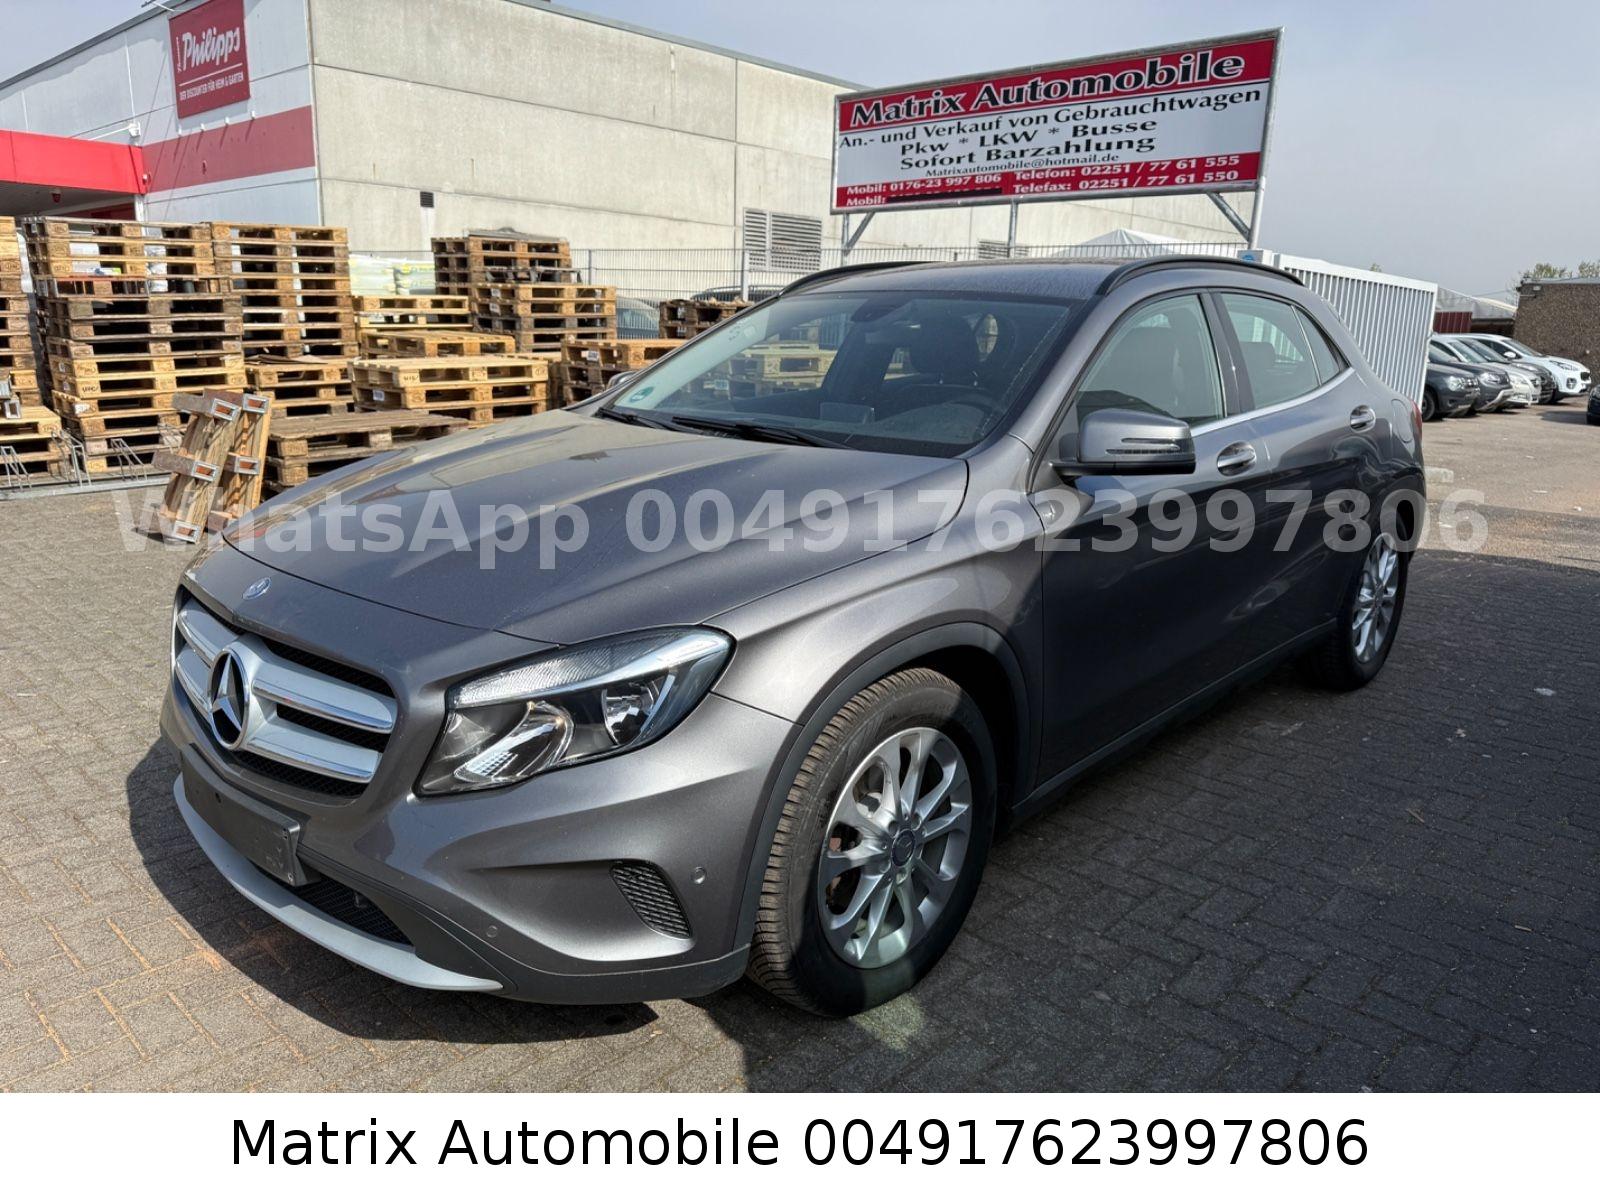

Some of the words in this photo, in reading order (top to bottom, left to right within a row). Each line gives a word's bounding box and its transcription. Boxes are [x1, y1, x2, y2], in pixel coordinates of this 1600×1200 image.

[182, 26, 240, 71] Philipps
[850, 89, 967, 127] Matrix
[969, 50, 1245, 111] Automobile
[839, 136, 875, 149] An.-
[881, 126, 916, 144] und
[924, 115, 1002, 138] Verkauf
[1009, 114, 1048, 128] von
[1054, 89, 1261, 123] Gebrauchtwagen
[901, 142, 949, 156] Pkw
[979, 129, 1038, 147] LKW
[1072, 120, 1158, 138] Busse
[900, 151, 976, 170] Sofort
[986, 137, 1156, 163] Barzahlung
[925, 153, 1119, 177] Matrixautomobile@hotmail.de
[1014, 167, 1076, 181] Telefon:
[1081, 164, 1131, 177] 02251
[1149, 161, 1172, 172] 77
[1175, 158, 1197, 170] 61
[1204, 155, 1240, 168] 555
[847, 183, 887, 195] Mobil:
[890, 179, 942, 192] 0176-23
[945, 176, 972, 187] 997
[975, 173, 1001, 184] 806
[1013, 181, 1071, 194] Telefax:
[1078, 178, 1128, 190] 02251
[1147, 175, 1169, 186] 77
[1174, 173, 1195, 185] 61
[1203, 170, 1239, 183] 550
[846, 194, 886, 207] Mobil:
